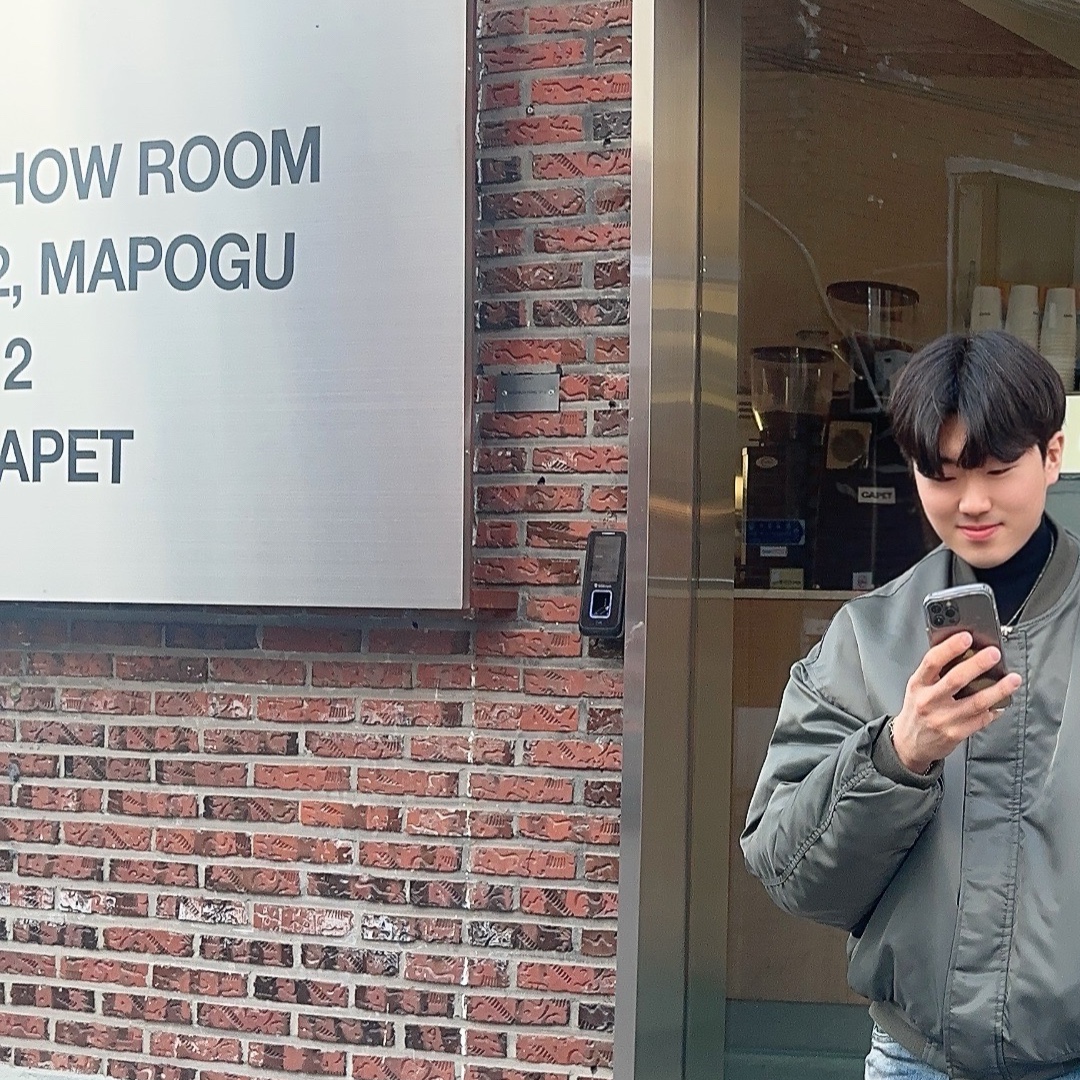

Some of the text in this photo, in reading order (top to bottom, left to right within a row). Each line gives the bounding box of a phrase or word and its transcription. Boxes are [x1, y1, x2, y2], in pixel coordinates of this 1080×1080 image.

[139, 126, 321, 196] ROOM
[41, 232, 296, 295] MAPOGU
[4, 337, 33, 391] 2
[0, 429, 135, 485] APET
